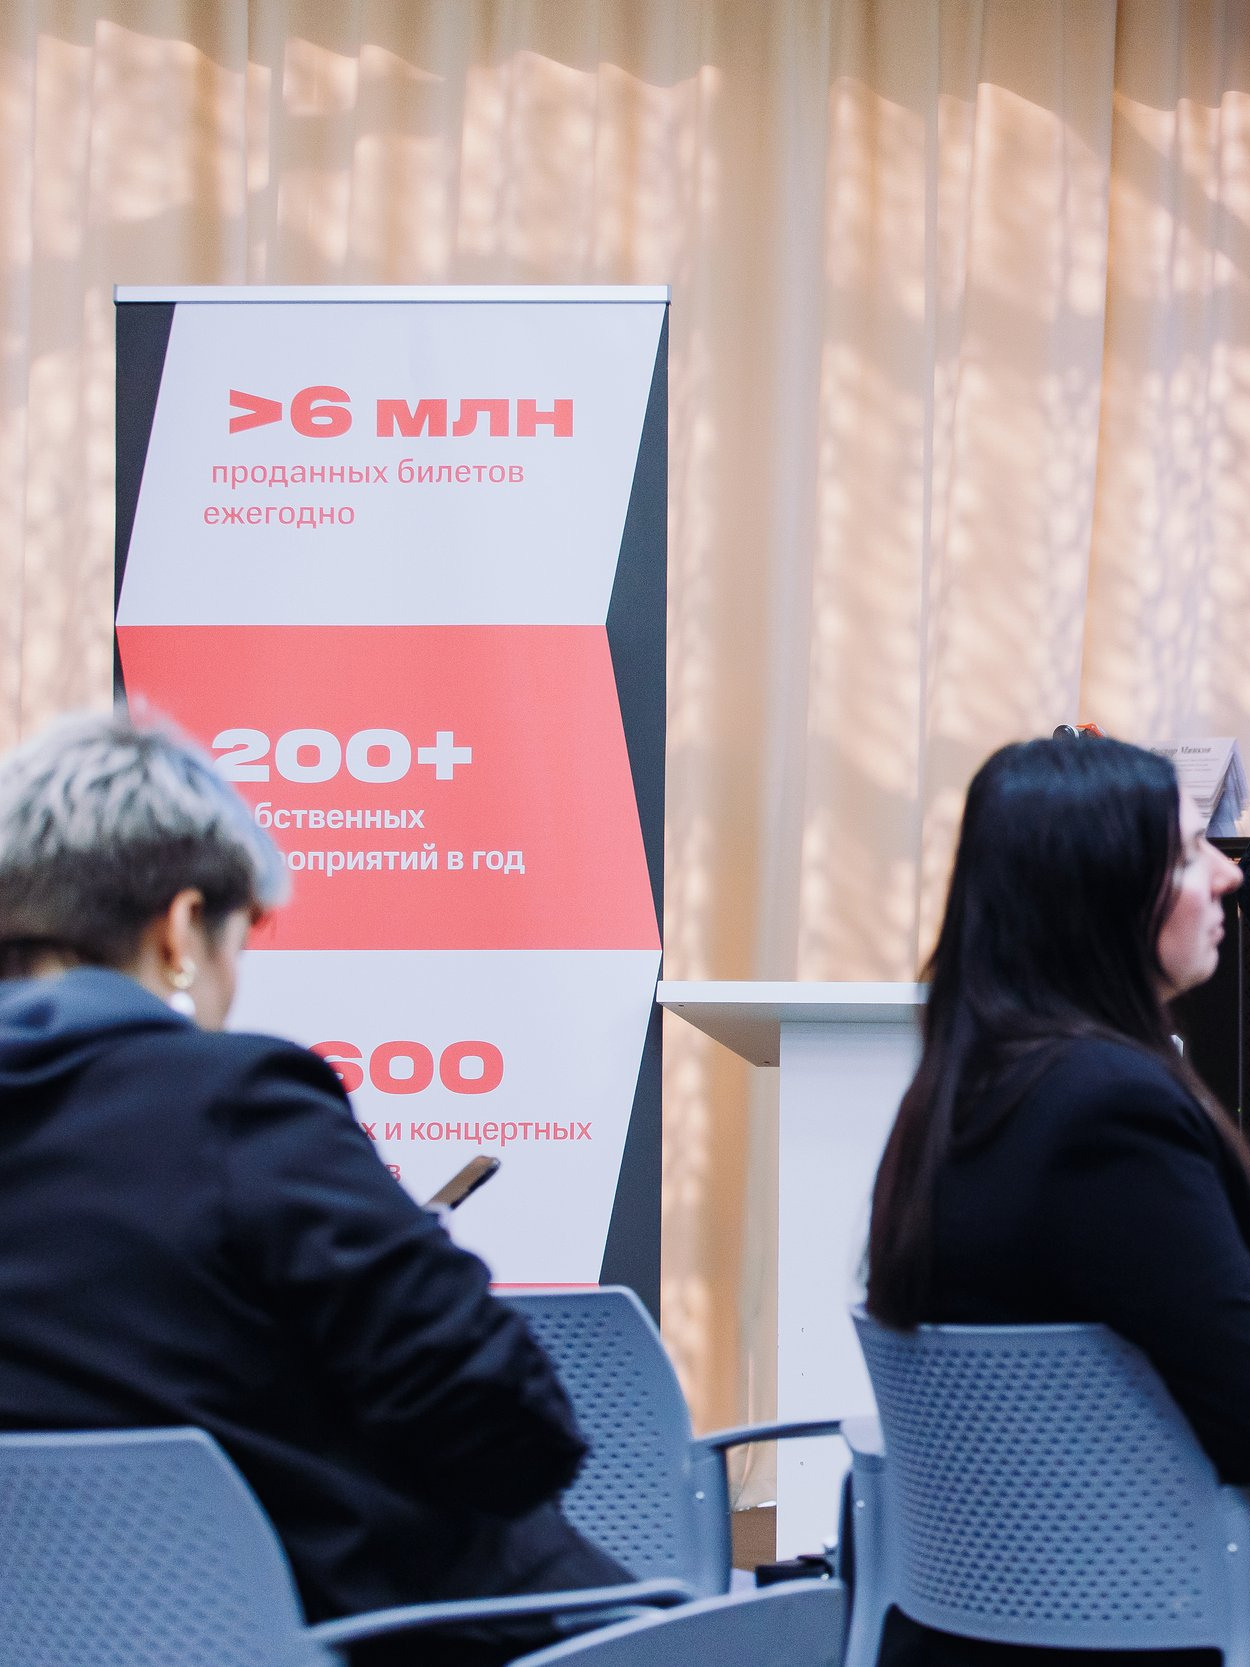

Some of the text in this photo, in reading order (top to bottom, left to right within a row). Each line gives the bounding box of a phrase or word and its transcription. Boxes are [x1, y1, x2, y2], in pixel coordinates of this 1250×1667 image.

[376, 398, 574, 438] млн
[211, 458, 525, 488] проданных билетов
[203, 503, 356, 529] ежегодно
[211, 728, 473, 784] 200+
[254, 801, 426, 830] бственных
[286, 842, 526, 877] оприятий в год
[384, 1121, 402, 1141] и
[410, 1121, 593, 1148] концертных
